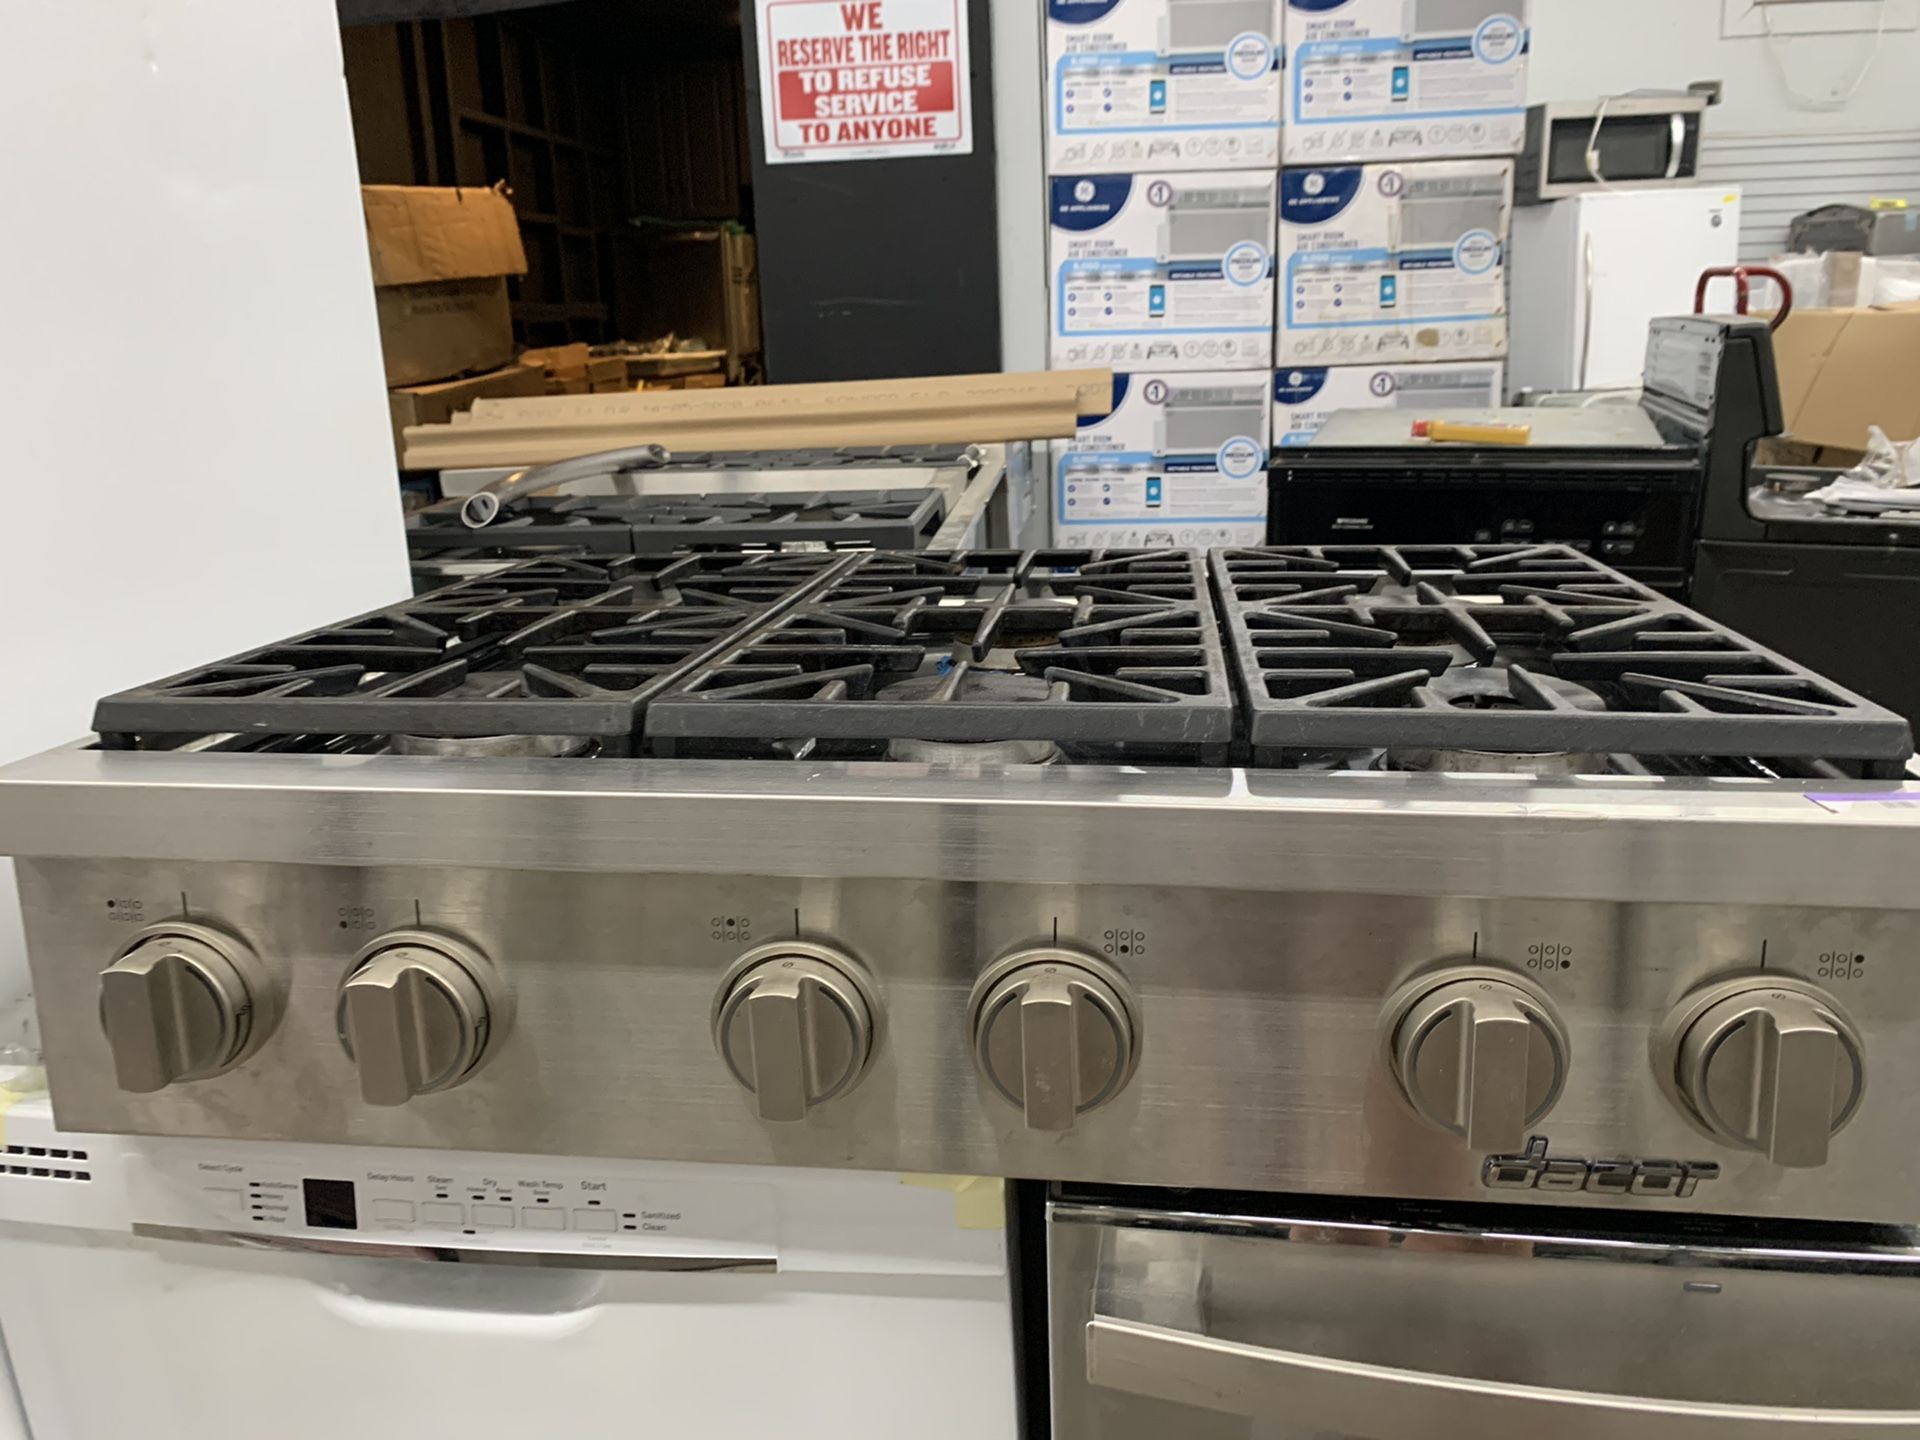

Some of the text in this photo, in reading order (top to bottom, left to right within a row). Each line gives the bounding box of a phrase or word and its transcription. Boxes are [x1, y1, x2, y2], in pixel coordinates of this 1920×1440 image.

[841, 2, 883, 31] WE
[778, 30, 950, 67] RESERVE THE RIGHT
[798, 64, 932, 94] TO REFUSE
[814, 90, 919, 118] SERVICE
[799, 116, 937, 144] TO ANYONE
[1481, 1135, 1720, 1197] dacor
[518, 1180, 564, 1190] Wash Temp
[581, 1180, 607, 1191] Start
[641, 1211, 681, 1221] Sanitized
[642, 1222, 667, 1231] Clean
